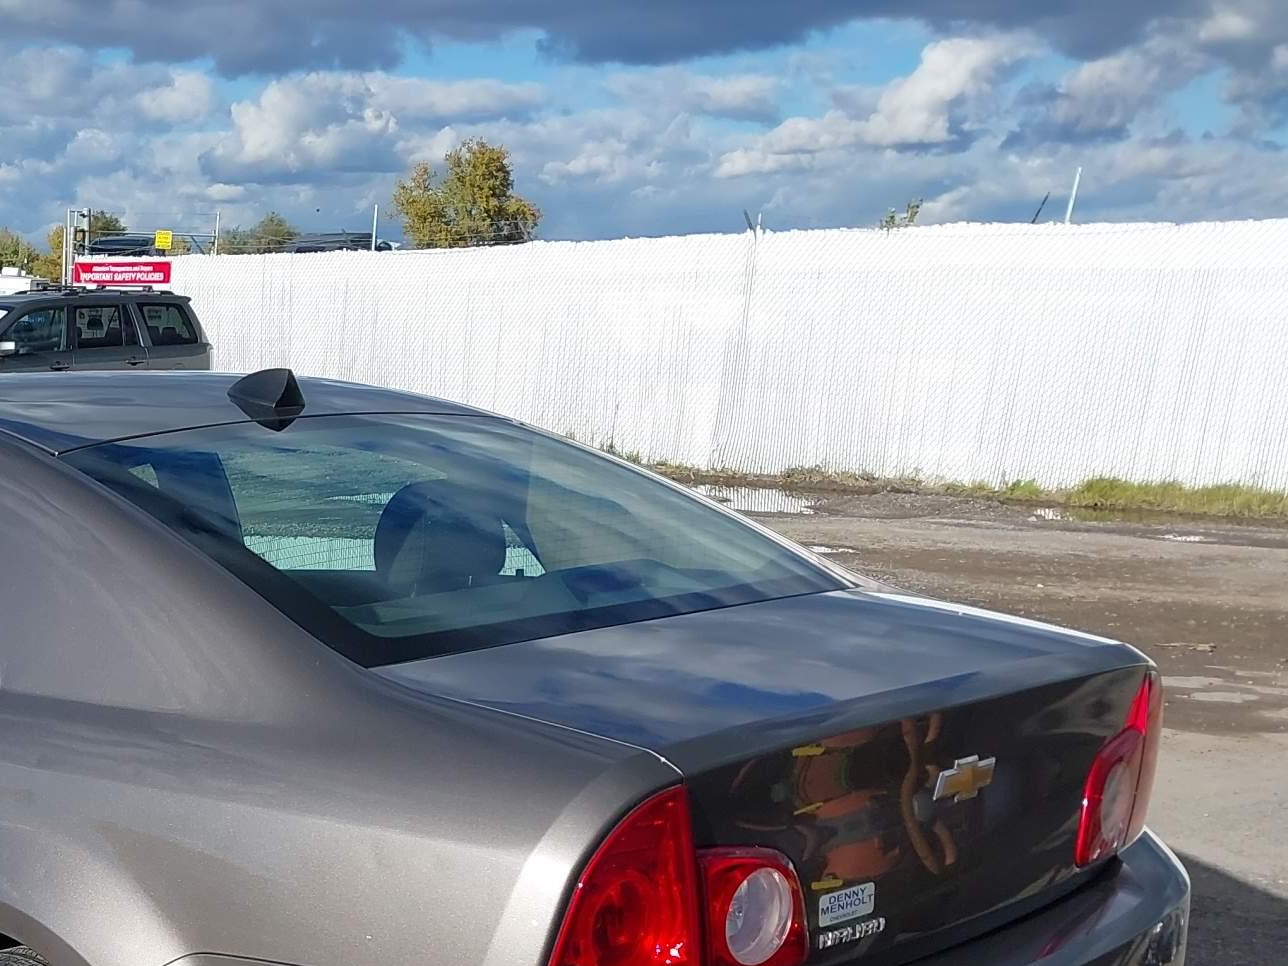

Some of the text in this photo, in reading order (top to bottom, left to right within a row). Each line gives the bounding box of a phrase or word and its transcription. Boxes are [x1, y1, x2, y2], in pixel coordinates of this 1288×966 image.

[81, 272, 164, 281] IMPORTANT SAFETY POLICIES
[828, 887, 866, 904] DENNY
[821, 894, 874, 915] MENHOLT
